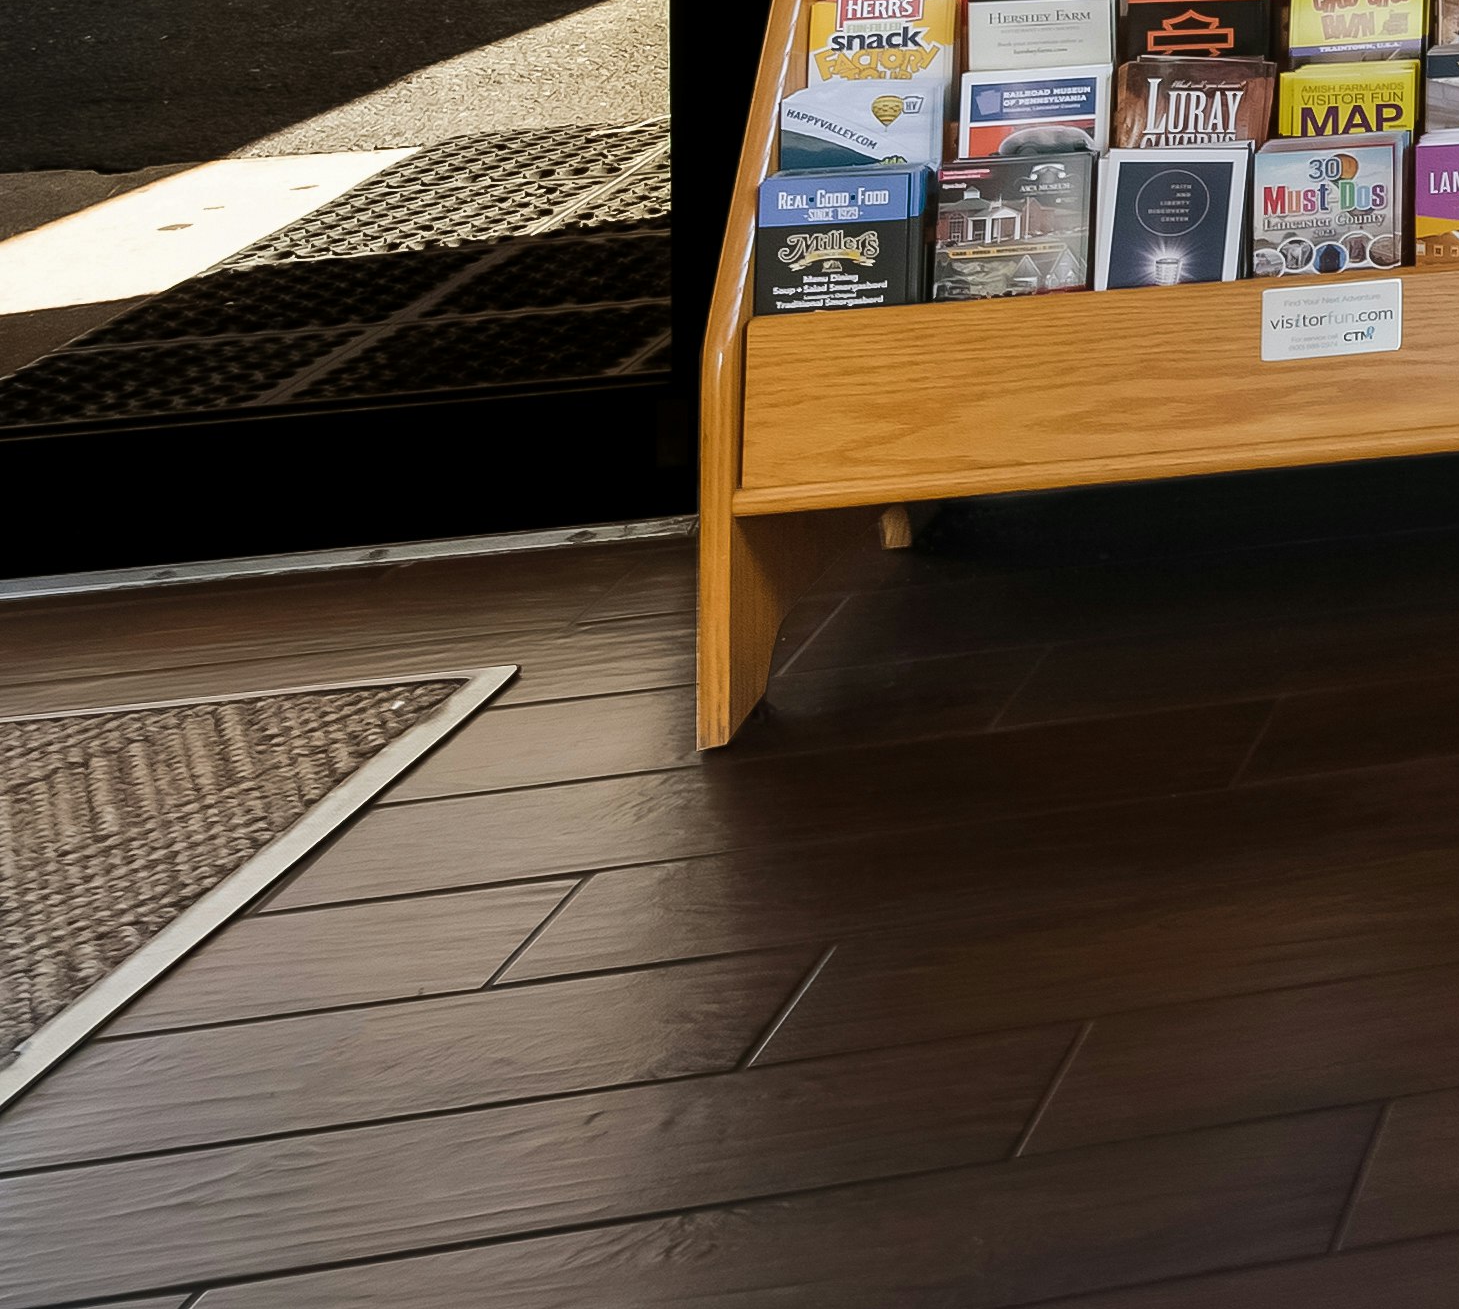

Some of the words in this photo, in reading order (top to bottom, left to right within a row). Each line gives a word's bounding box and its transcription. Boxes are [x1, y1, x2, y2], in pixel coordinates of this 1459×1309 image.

[989, 12, 1051, 25] HERSHEY
[1056, 9, 1092, 21] FARM
[1321, 12, 1376, 40] BARN
[831, 26, 923, 52] snack
[814, 44, 940, 82] FACTORY
[1003, 88, 1050, 99] RAILROAD
[1053, 86, 1091, 95] MUSEUM
[1301, 85, 1337, 94] AMISH
[1338, 82, 1405, 92] FARMLANDS
[1301, 93, 1366, 105] VISITOR
[1371, 91, 1404, 103] FUN
[1003, 99, 1016, 107] OF
[1018, 95, 1087, 106] PENNSYLVANIA
[1142, 78, 1245, 133] LURAY
[786, 108, 878, 150] HAPPYVALLEY.COM
[1301, 103, 1403, 137] MAP
[1308, 158, 1340, 180] 30
[816, 189, 849, 208] GOOD
[857, 187, 889, 205] FOOD
[1264, 218, 1331, 231] Lancaster
[1335, 213, 1385, 226] County
[778, 229, 880, 263] Miller's
[1269, 308, 1394, 331] visitorfun.com
